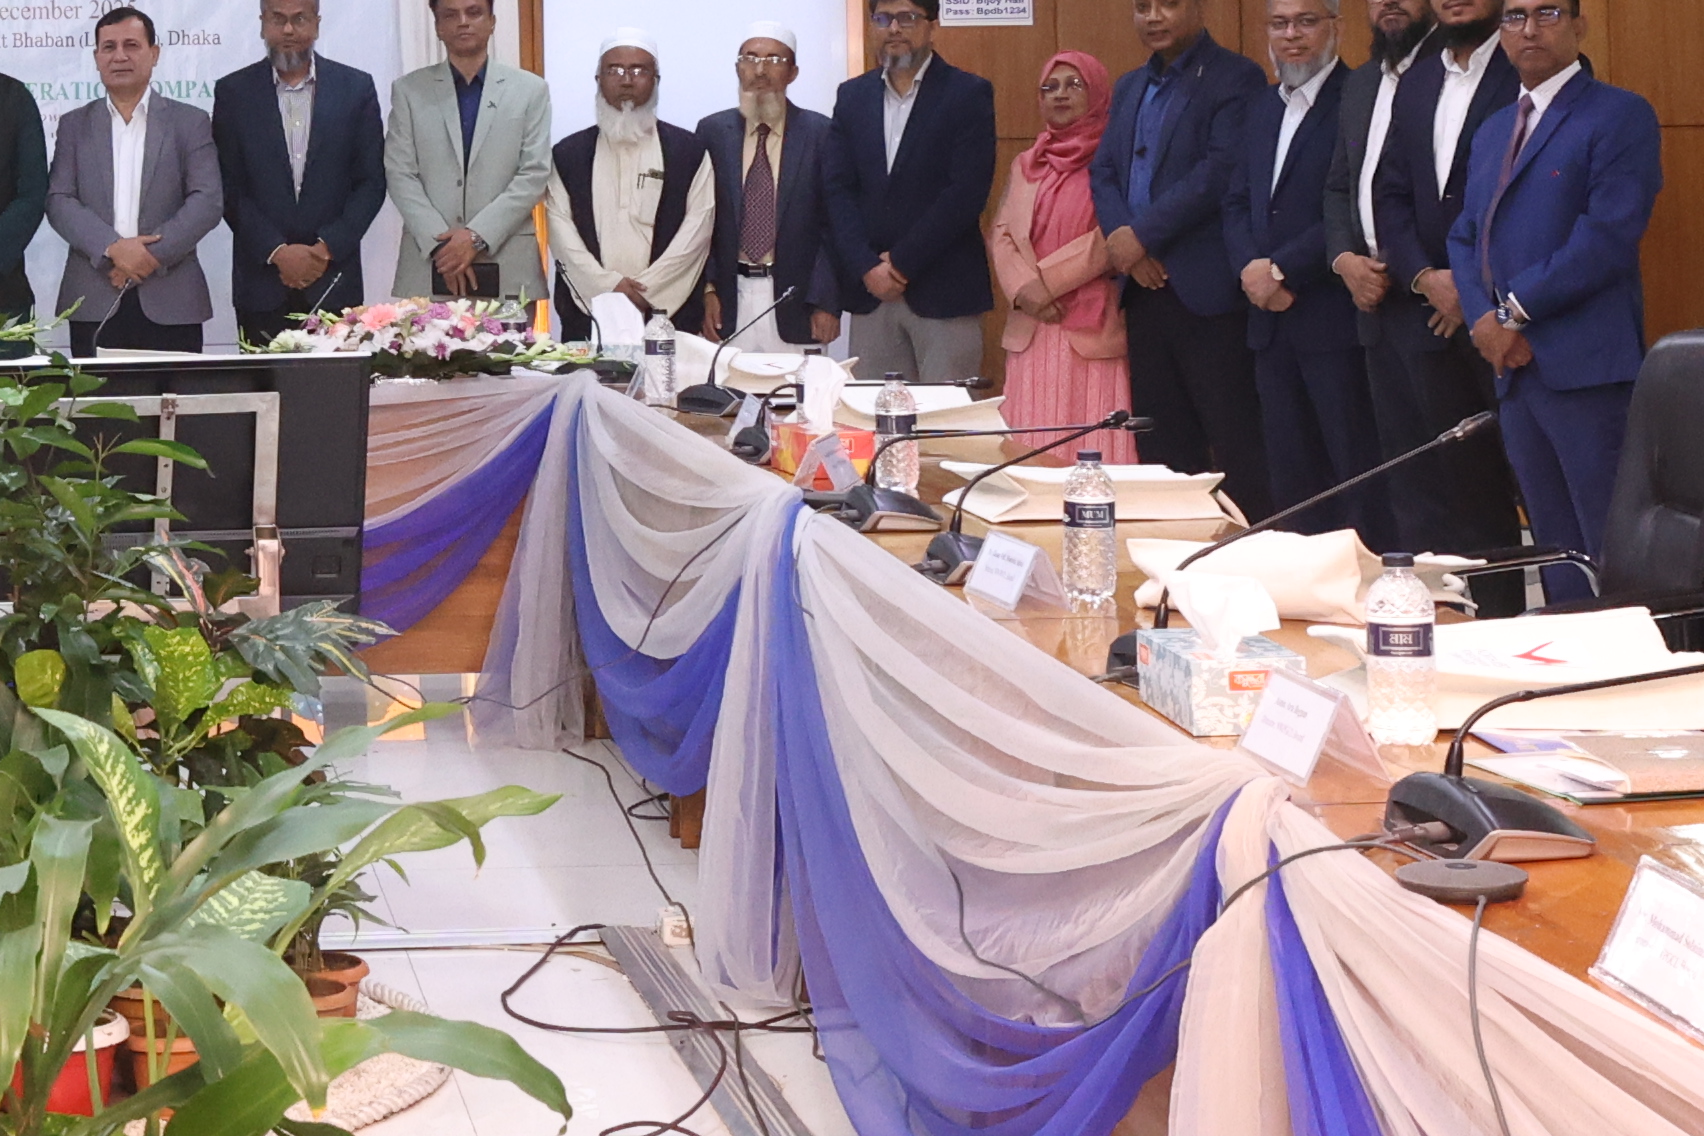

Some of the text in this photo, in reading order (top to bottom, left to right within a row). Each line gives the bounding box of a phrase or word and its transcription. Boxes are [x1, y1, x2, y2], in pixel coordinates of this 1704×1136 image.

[12, 31, 76, 48] Bhaban
[168, 28, 222, 46] Dhaka
[1081, 509, 1104, 519] MUM
